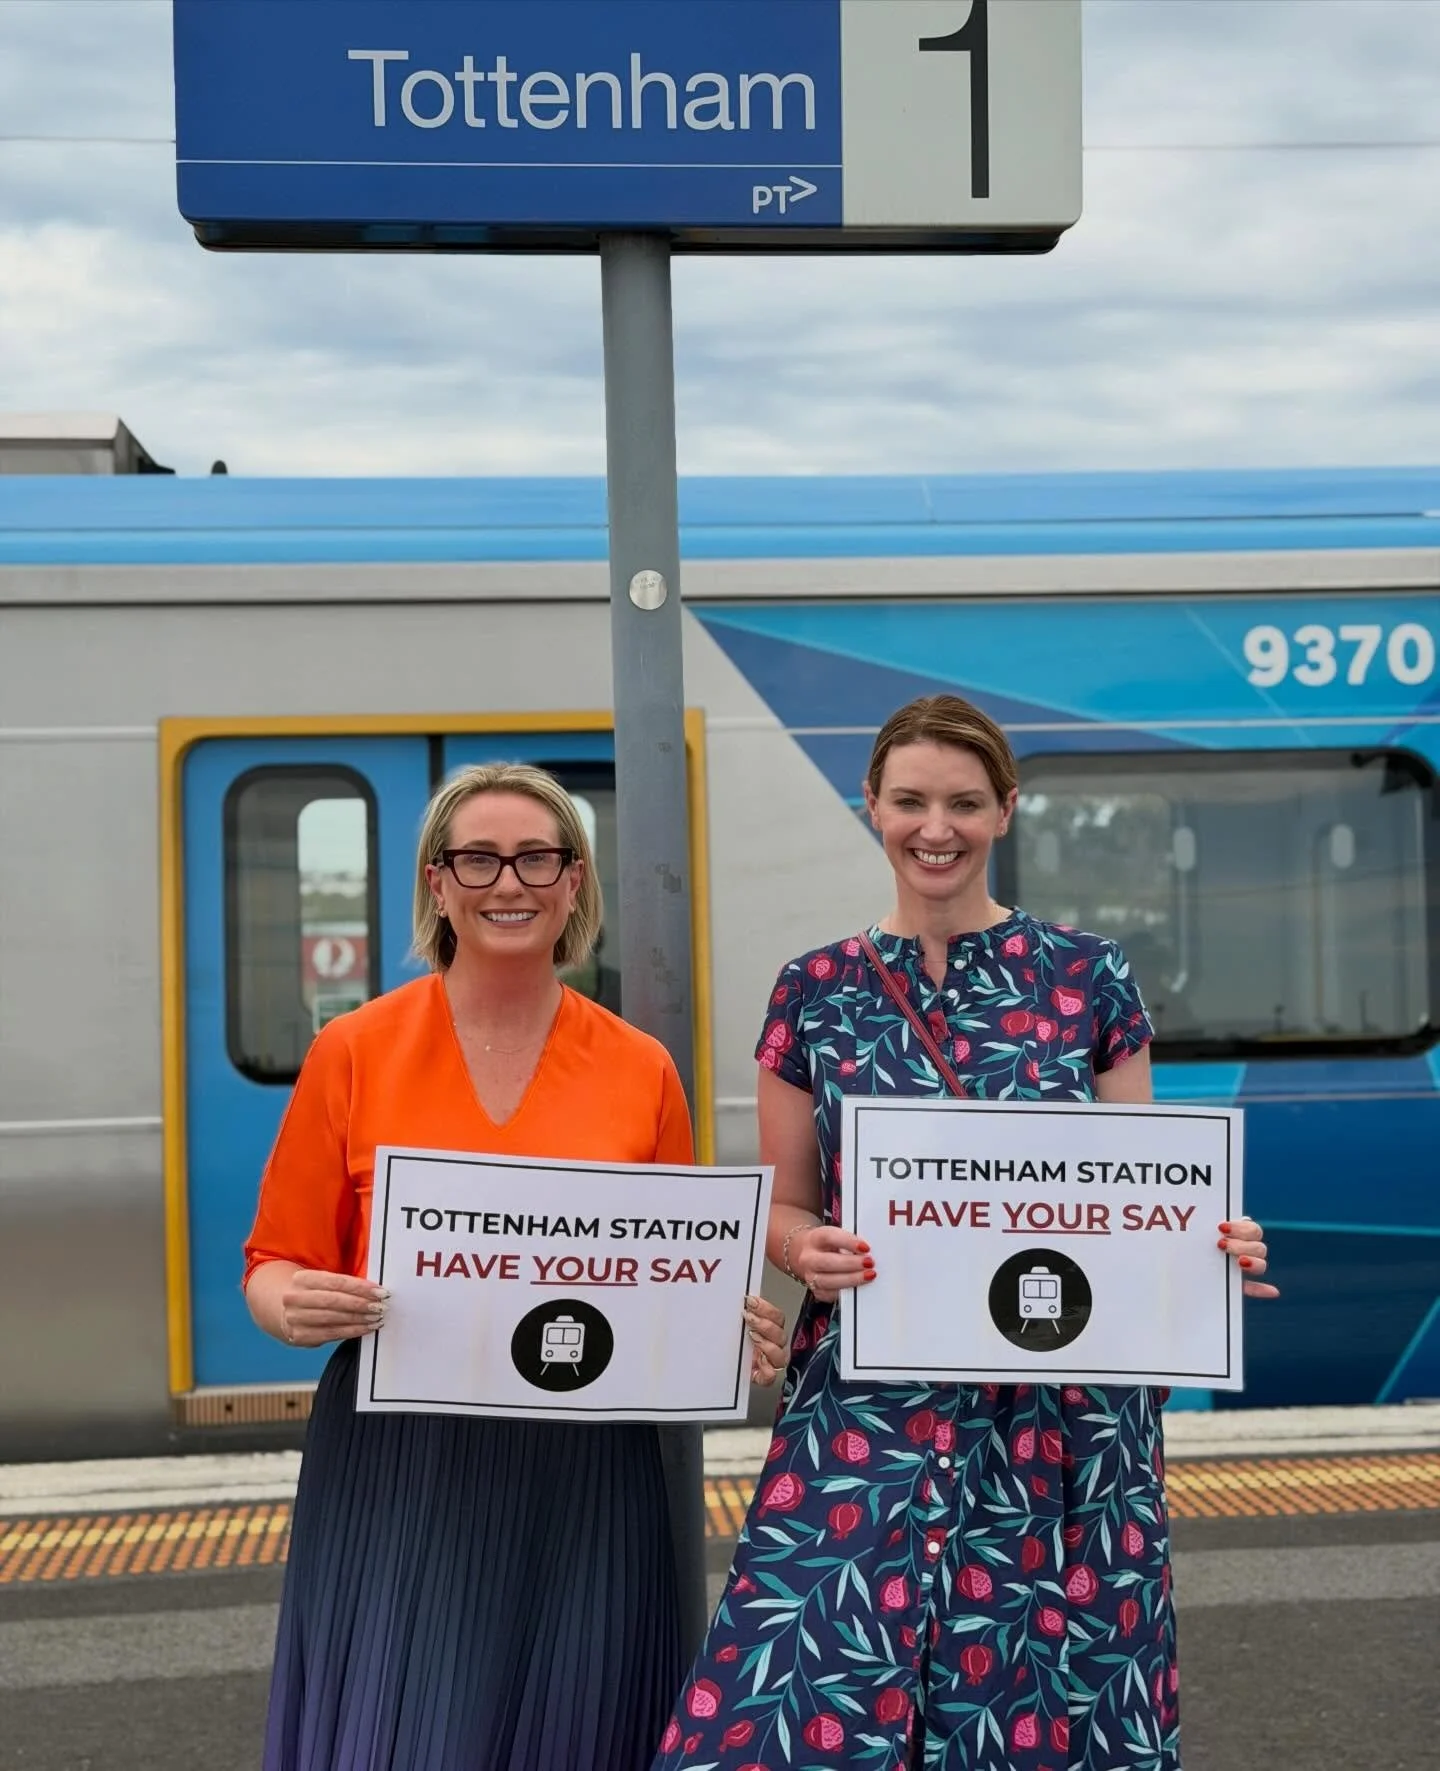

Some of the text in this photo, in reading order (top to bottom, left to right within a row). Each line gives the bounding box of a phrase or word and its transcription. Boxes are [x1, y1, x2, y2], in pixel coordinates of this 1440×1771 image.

[347, 49, 816, 130] Tottenham
[918, 0, 989, 198] 1
[1243, 623, 1435, 687] 9370
[869, 1157, 1212, 1187] TOTTENHAM STATION
[400, 1206, 741, 1242] TOTTENHAM STATION
[889, 1199, 1196, 1233] HAVE YOUR SAY
[415, 1250, 723, 1285] HAVE YOUR SAY
